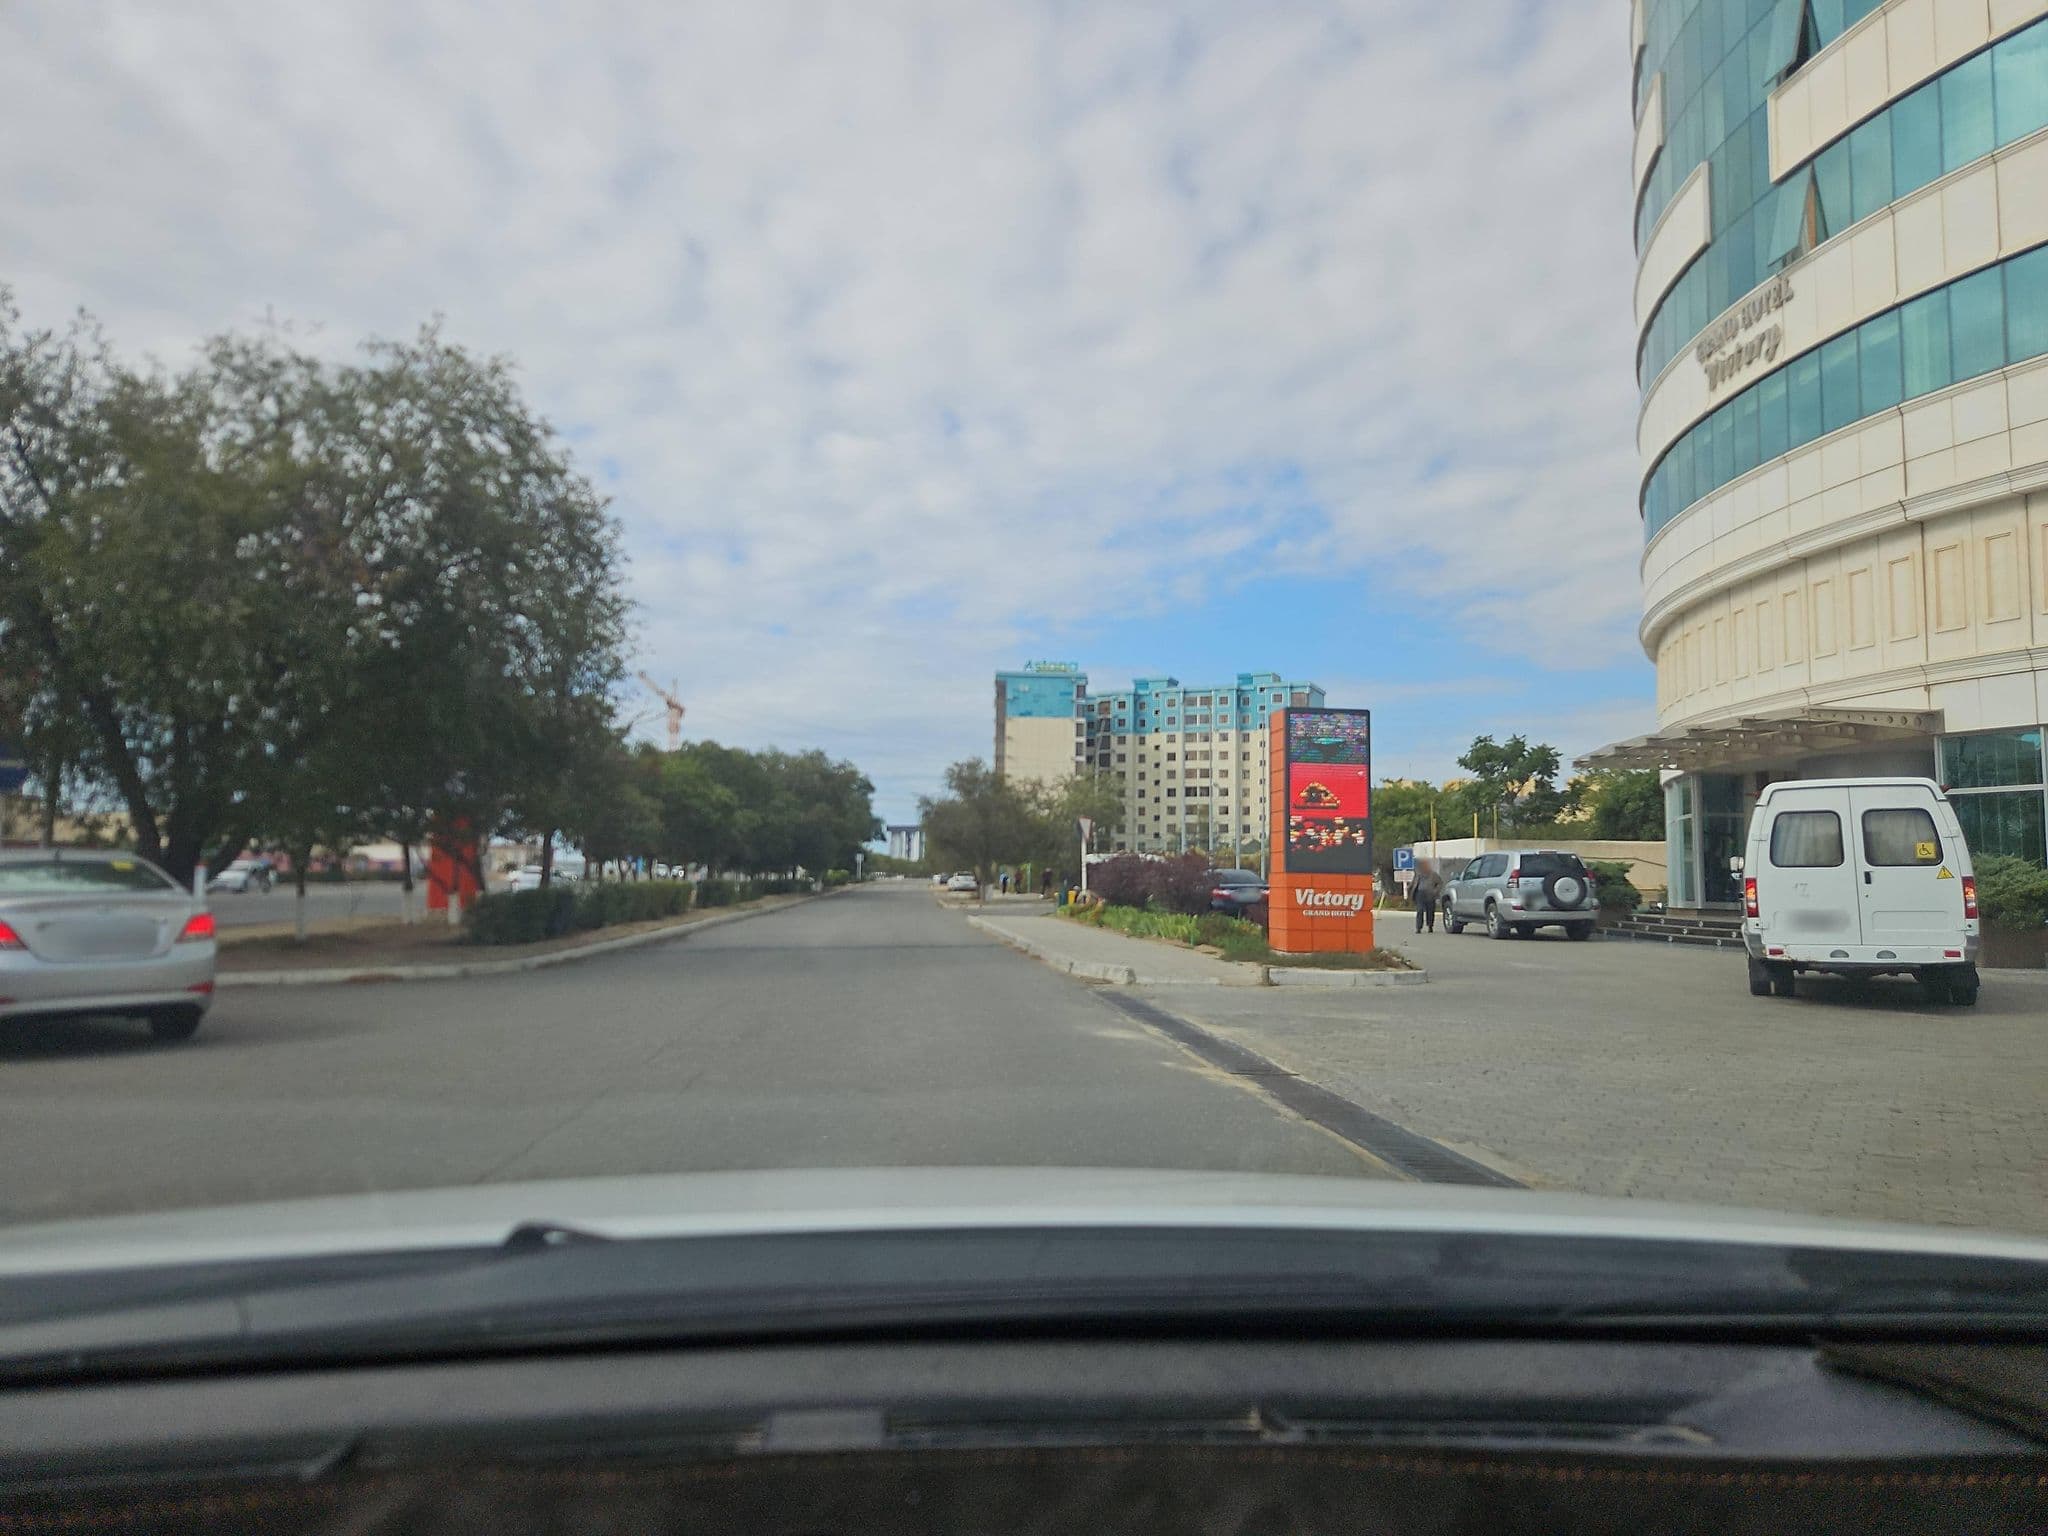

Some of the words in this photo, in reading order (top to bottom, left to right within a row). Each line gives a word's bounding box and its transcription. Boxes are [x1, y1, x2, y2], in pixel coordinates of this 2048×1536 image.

[1741, 277, 1794, 330] HOTEL
[1398, 850, 1409, 868] P
[1295, 888, 1364, 910] Victory
[1302, 909, 1330, 917] GRAND
[1331, 909, 1356, 917] HOTEL
